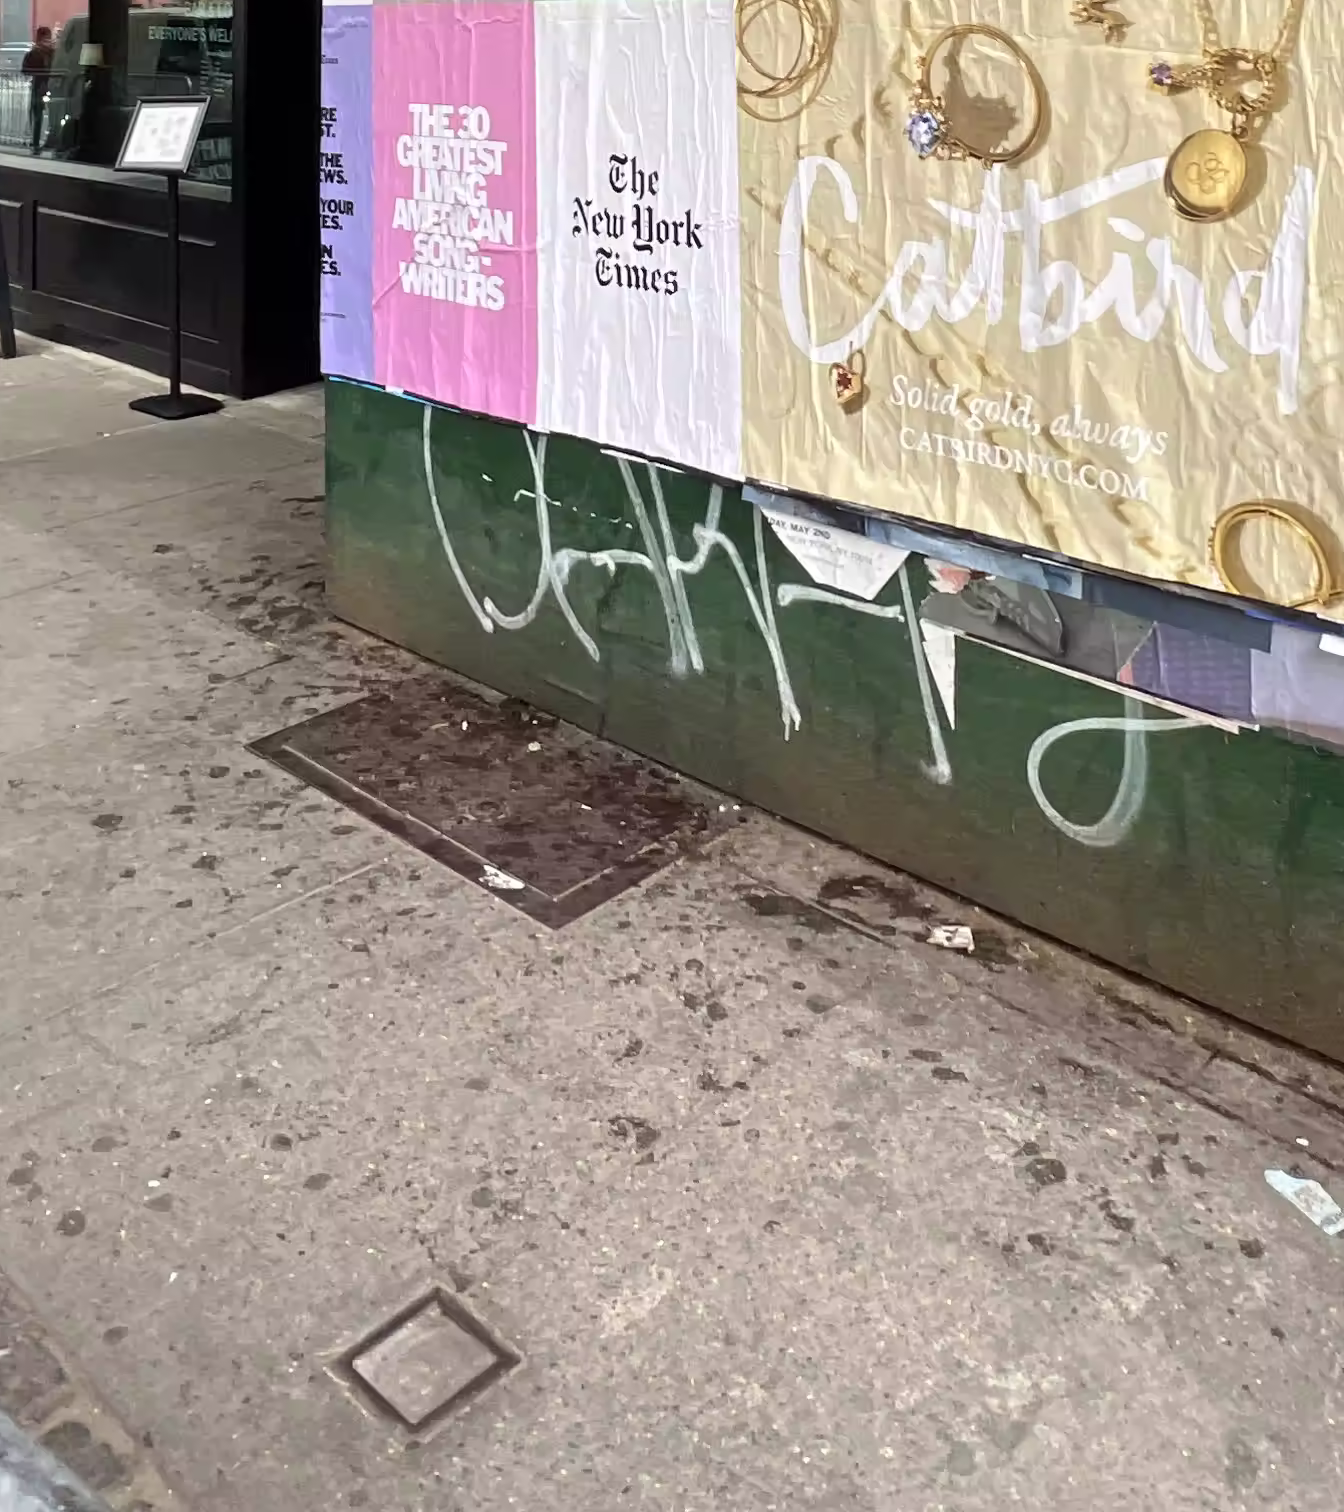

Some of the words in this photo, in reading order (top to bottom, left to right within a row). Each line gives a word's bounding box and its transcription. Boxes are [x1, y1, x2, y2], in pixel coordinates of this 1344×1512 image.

[408, 103, 455, 138] THE
[457, 104, 491, 140] 30
[396, 134, 507, 176] GREATEST
[608, 152, 659, 202] The
[320, 197, 354, 216] YOUR
[412, 167, 488, 208] LIVING
[392, 197, 514, 246] AMERICAN
[572, 196, 624, 241] New
[631, 203, 704, 254] York
[399, 260, 505, 311] WRITERS
[595, 246, 678, 296] Times
[778, 155, 1317, 415] Catbird
[889, 374, 961, 417] Solid
[964, 391, 1042, 437] gold,
[1049, 404, 1169, 465] always
[899, 426, 1149, 502] CATBIRDNYC.COM
[790, 523, 812, 536] MAY
[812, 527, 832, 540] 2ND
